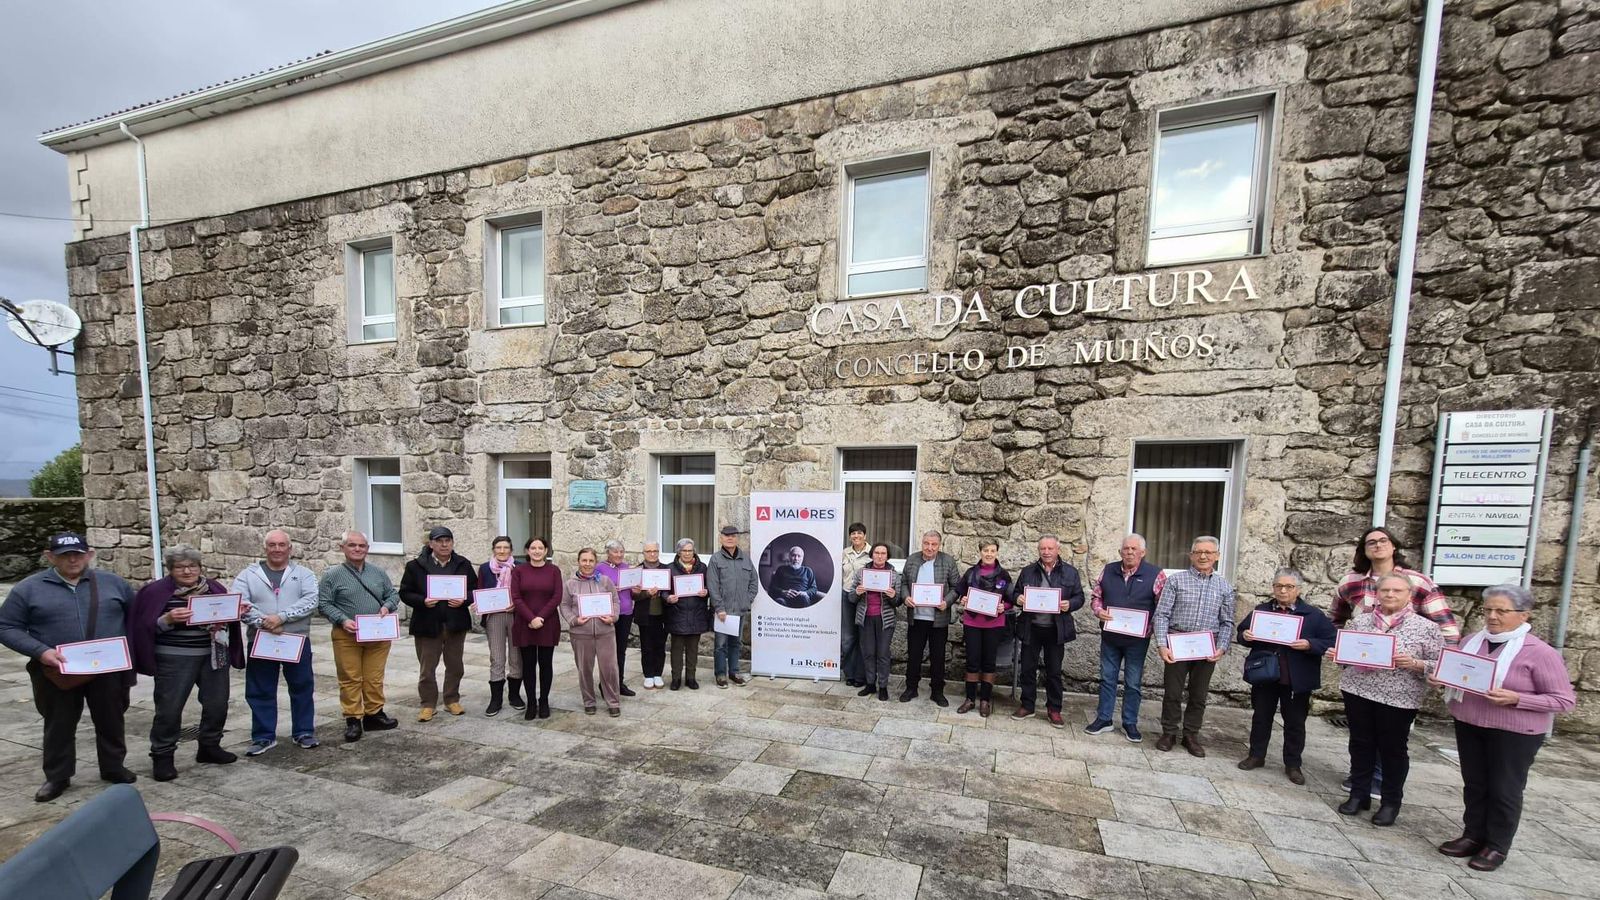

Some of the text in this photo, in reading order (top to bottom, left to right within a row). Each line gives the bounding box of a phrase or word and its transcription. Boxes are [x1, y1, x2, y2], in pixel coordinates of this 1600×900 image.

[811, 265, 1260, 335] CASA DA CULTURA
[835, 331, 1215, 379] CONCELLO DE MUIÑOS
[1453, 471, 1527, 479] TELECENTRO
[791, 658, 803, 666] La
